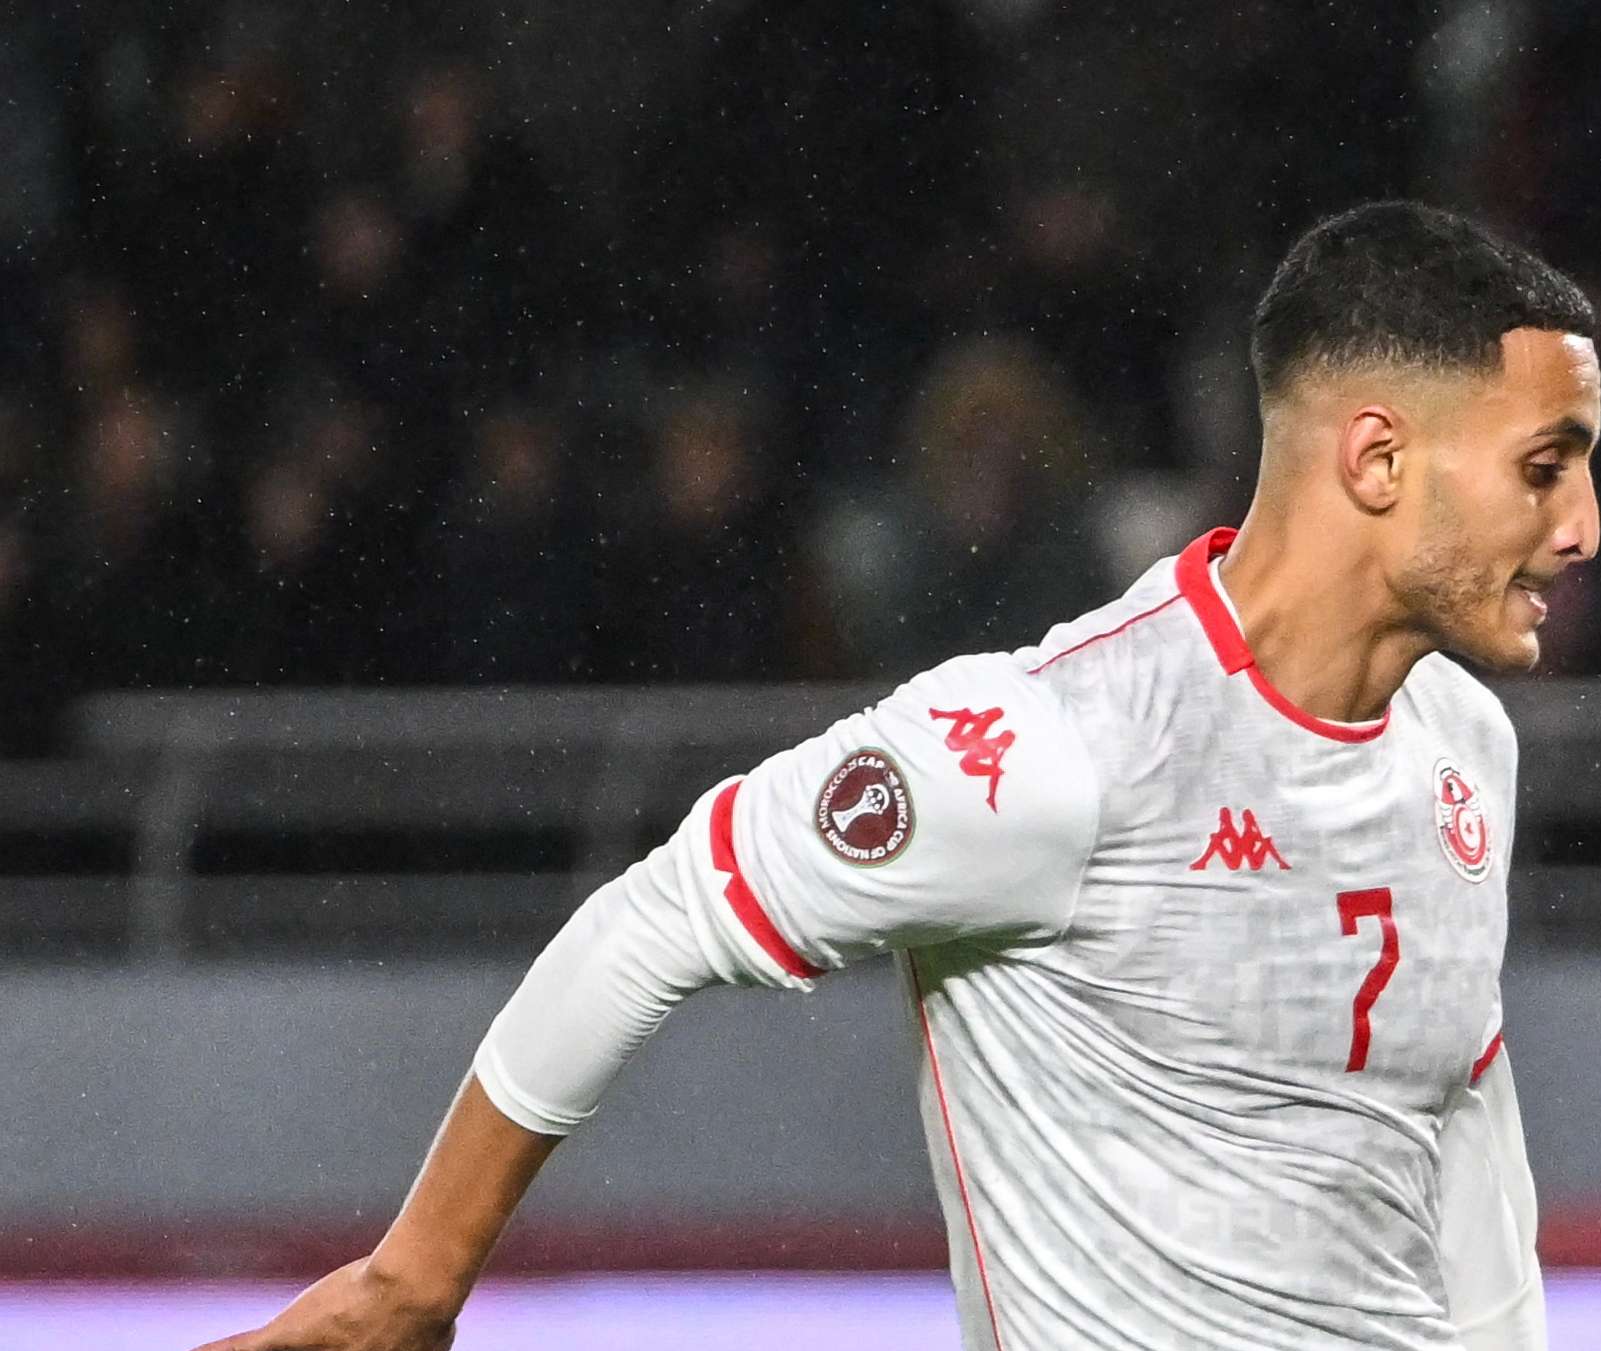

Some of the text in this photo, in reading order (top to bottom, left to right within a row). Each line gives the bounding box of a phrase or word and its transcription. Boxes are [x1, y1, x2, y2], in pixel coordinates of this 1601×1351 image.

[819, 768, 848, 829] MOROCCO
[893, 788, 908, 829] AFRICA
[826, 829, 870, 860] NATIONS
[870, 846, 886, 859] OF
[886, 830, 904, 851] CUP
[1336, 887, 1400, 1073] 7
